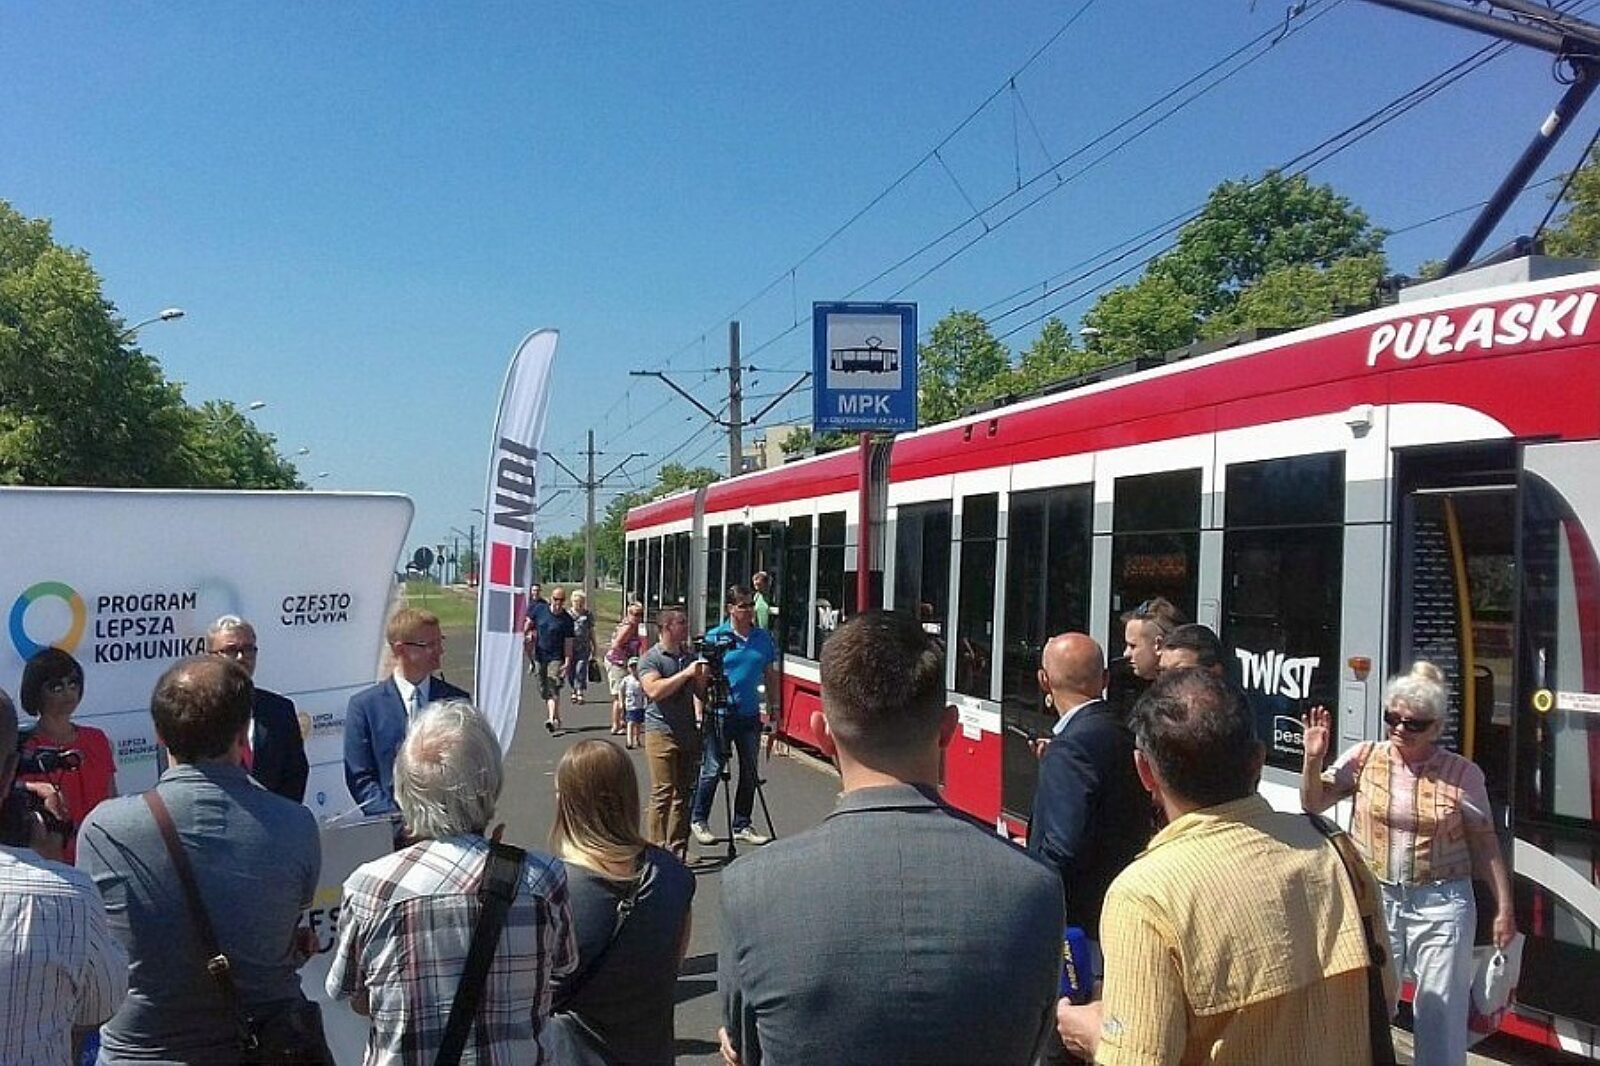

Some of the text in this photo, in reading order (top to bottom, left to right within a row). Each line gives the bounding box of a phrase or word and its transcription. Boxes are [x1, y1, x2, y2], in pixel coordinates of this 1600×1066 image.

[1366, 292, 1598, 366] PUŁASKI
[838, 394, 891, 414] MPK
[493, 437, 538, 533] NDI
[97, 592, 197, 614] PROGRAM
[95, 616, 175, 638] LEPSZA
[1235, 647, 1320, 699] TWIST
[1274, 729, 1304, 744] pes
